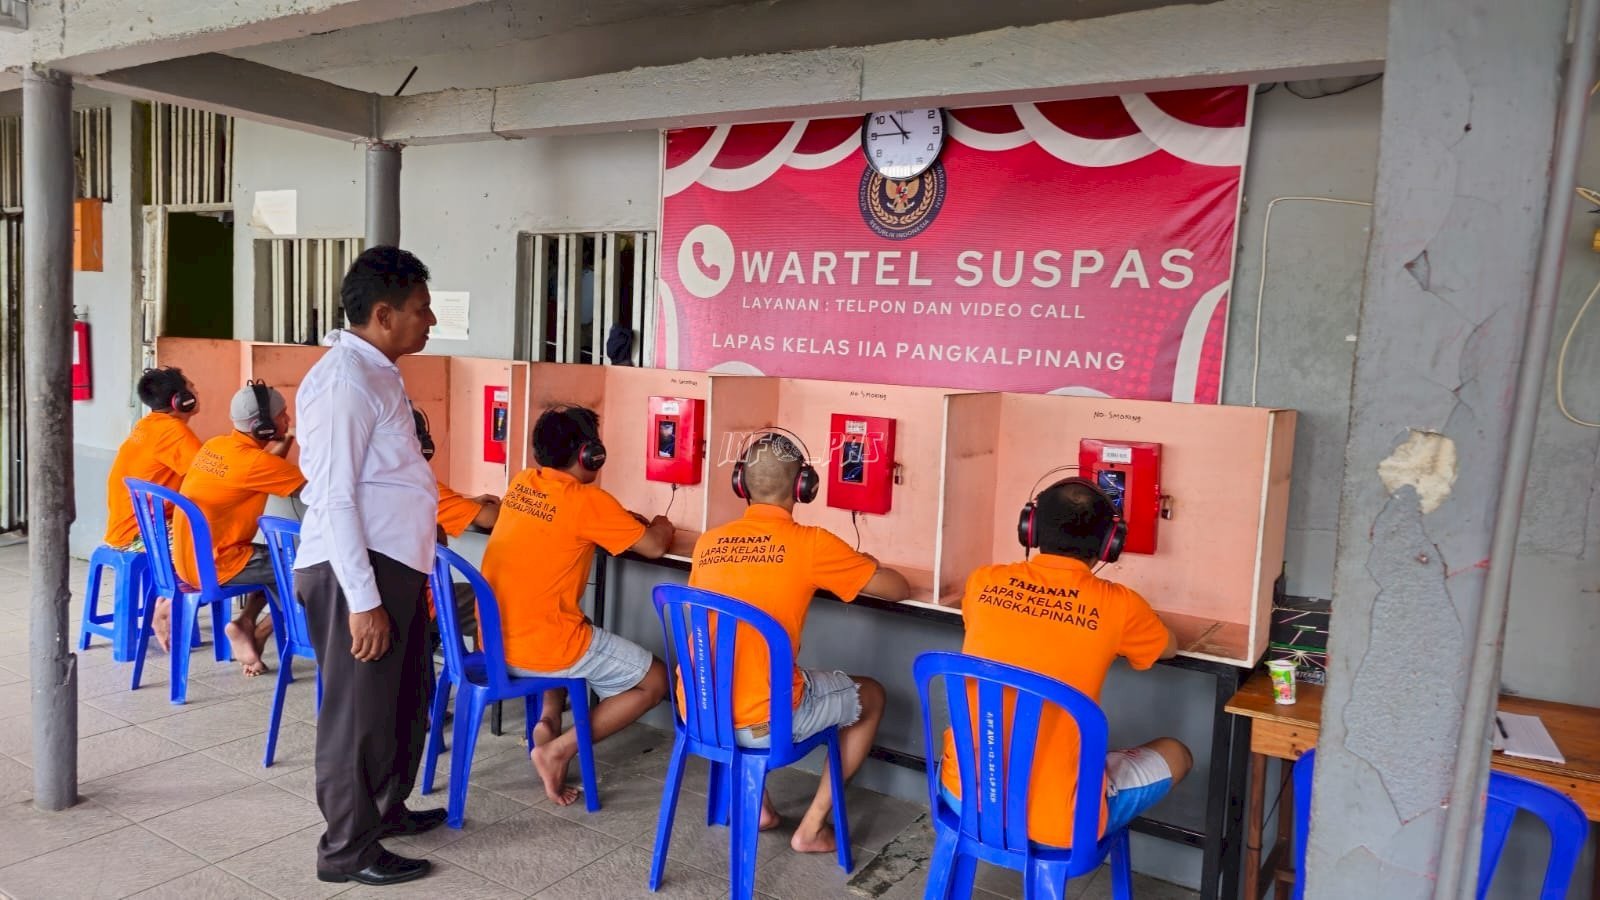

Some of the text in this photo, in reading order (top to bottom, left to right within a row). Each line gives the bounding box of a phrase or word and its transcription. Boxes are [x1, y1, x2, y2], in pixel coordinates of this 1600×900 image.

[874, 115, 886, 125] 10
[927, 109, 936, 119] 2
[932, 125, 940, 135] 3
[926, 143, 934, 152] 4
[741, 248, 1195, 290] WARTEL SUSPAS
[742, 296, 820, 312] LAYANAN
[835, 299, 907, 314] TELPON
[912, 300, 953, 315] DAN
[960, 302, 1022, 318] VIDEO
[1030, 303, 1086, 319] CALL
[711, 332, 1126, 371] LAPAS KELAS IIA PANGKALPINANG
[716, 534, 774, 545] TAHANAN
[700, 544, 787, 559] LAPAS KELAS II A
[698, 554, 785, 568] PANGKALPINANG
[1008, 577, 1080, 599] TAHANAN
[983, 584, 1100, 619] LAPAS KELAS II A
[978, 593, 1098, 631] PANGKALPINANG
